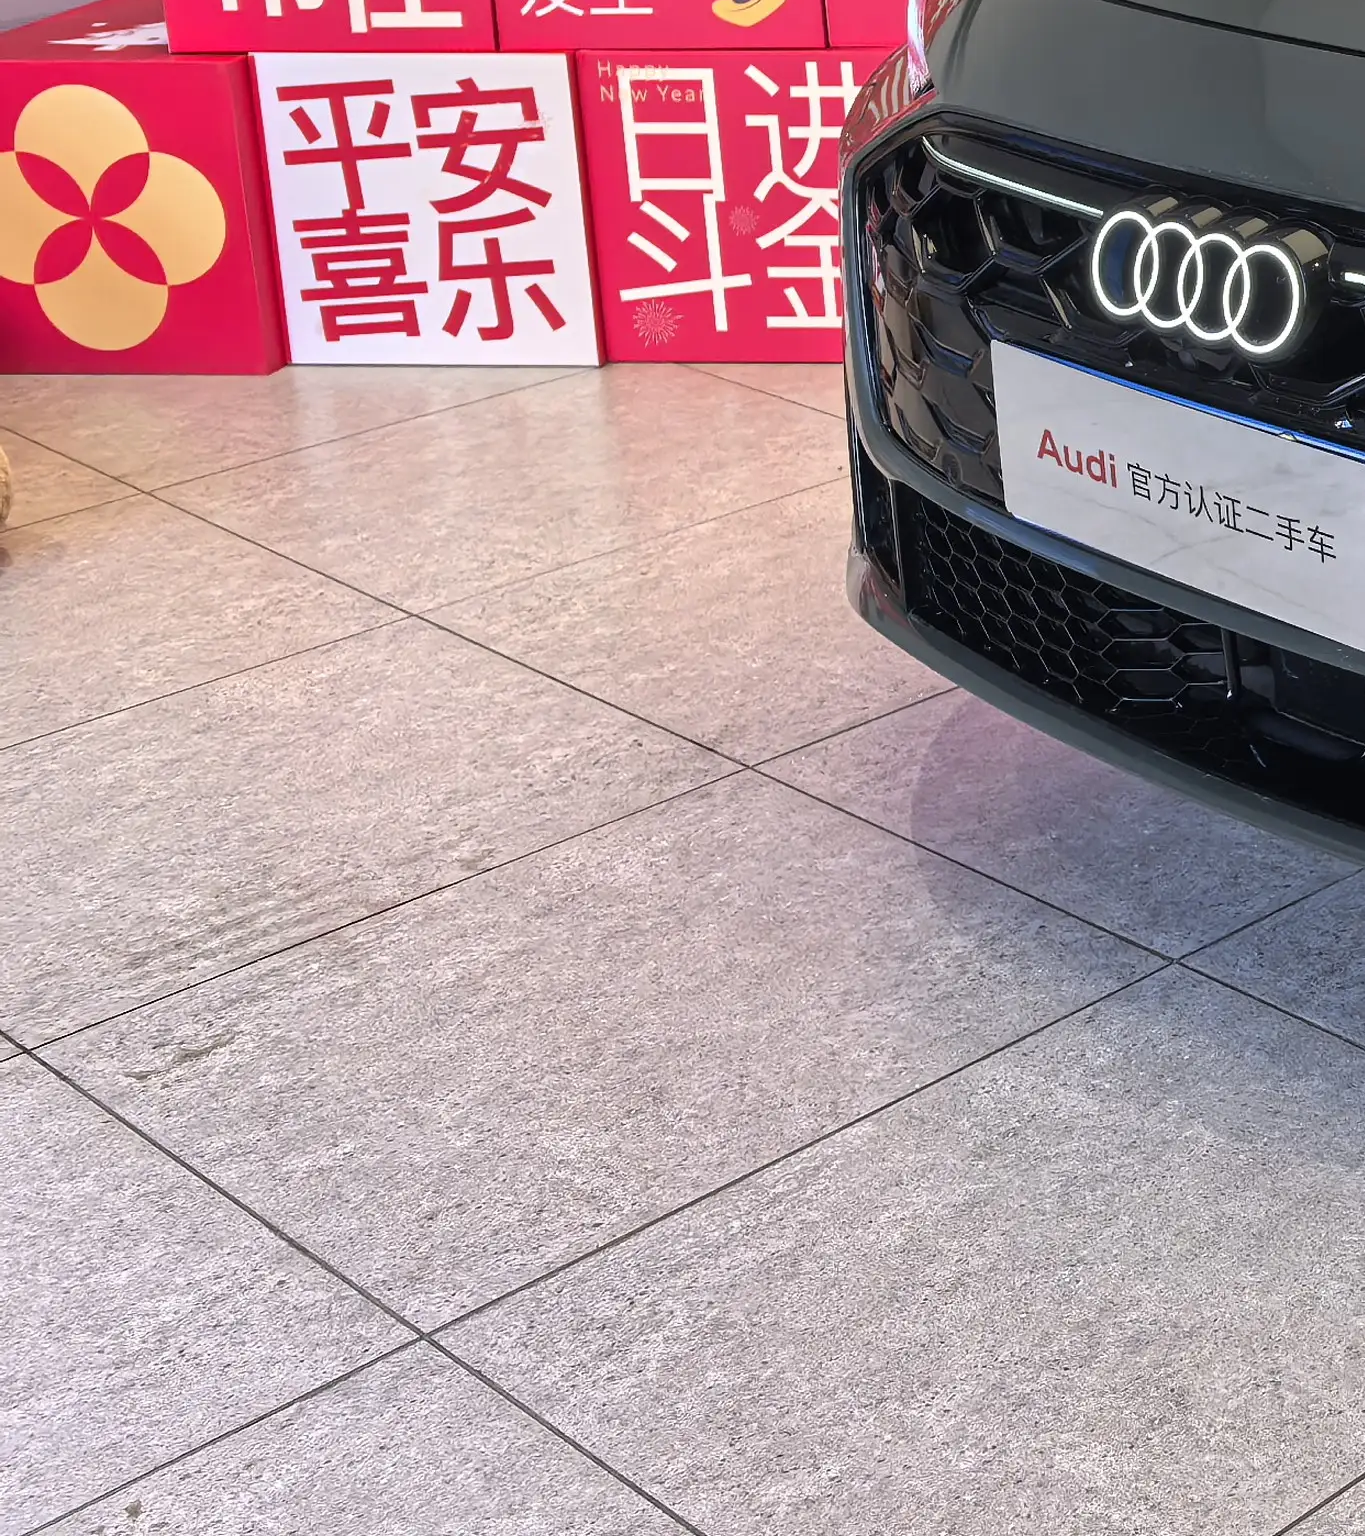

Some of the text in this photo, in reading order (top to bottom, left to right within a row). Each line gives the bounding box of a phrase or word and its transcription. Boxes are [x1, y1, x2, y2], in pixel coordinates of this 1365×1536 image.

[600, 84, 648, 102] Nw
[1037, 429, 1337, 563] Audi 官方认证二手车
